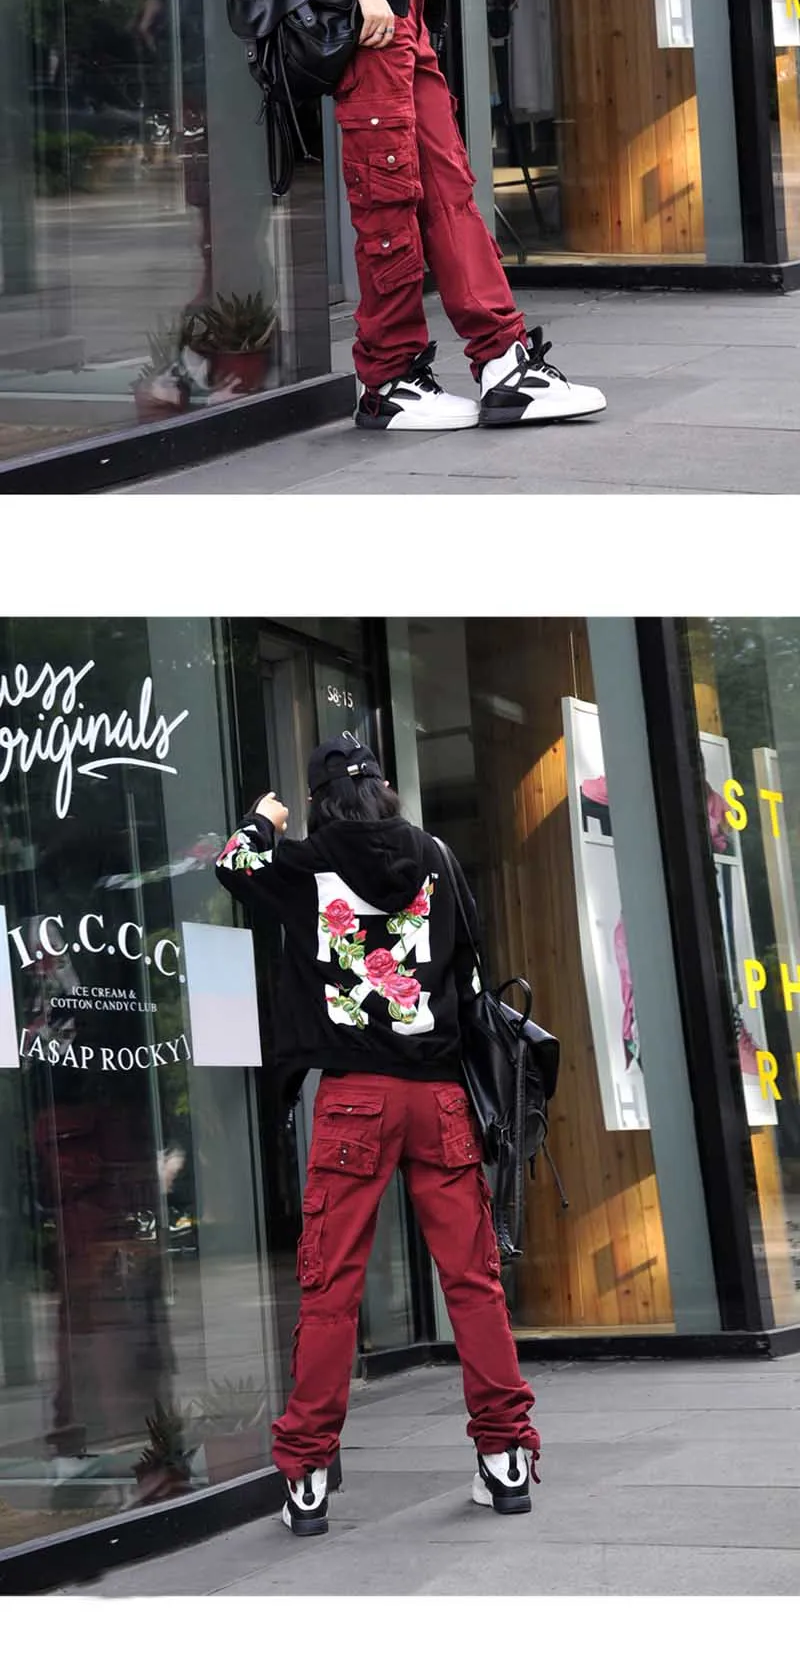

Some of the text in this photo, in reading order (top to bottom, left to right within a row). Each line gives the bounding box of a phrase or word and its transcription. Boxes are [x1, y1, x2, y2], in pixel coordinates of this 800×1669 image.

[8, 914, 186, 983] I.C.C.C.C.
[51, 997, 93, 1010] COTTON
[72, 986, 137, 999] ICE CREAM &
[20, 1028, 94, 1069] [A$AP
